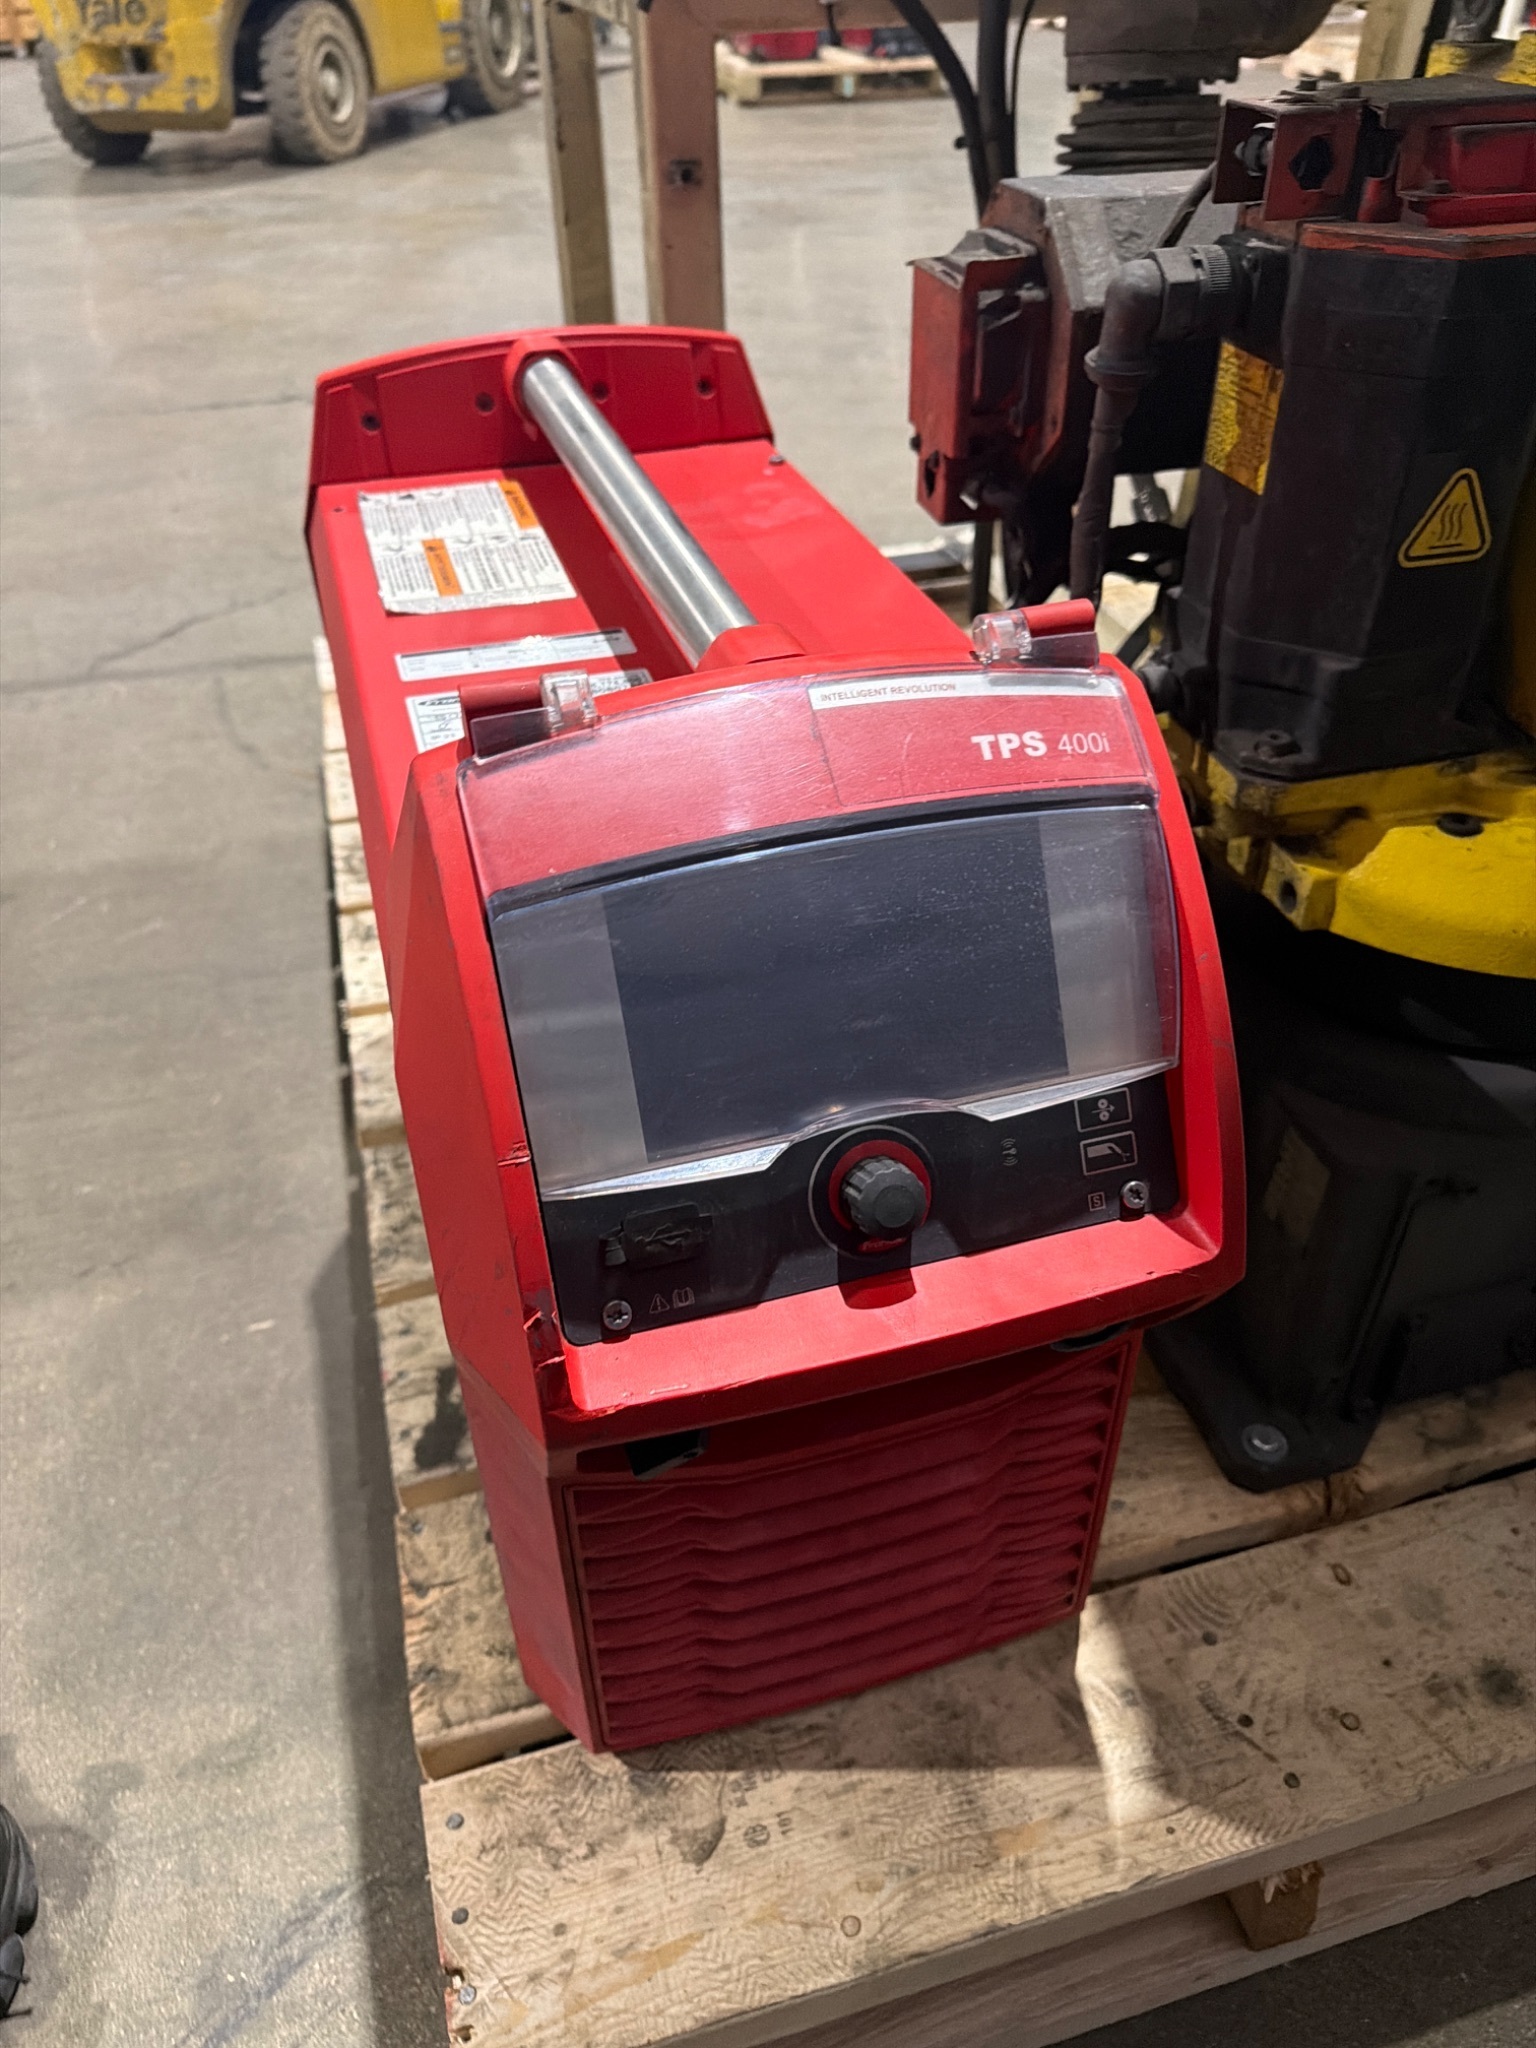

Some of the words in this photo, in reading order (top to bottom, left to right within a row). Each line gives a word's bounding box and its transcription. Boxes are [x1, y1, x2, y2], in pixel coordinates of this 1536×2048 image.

[820, 687, 888, 702] INTELLIGENT
[890, 683, 957, 695] REVOLUTION
[970, 731, 1048, 760] TPS
[1058, 732, 1111, 754] 400i
